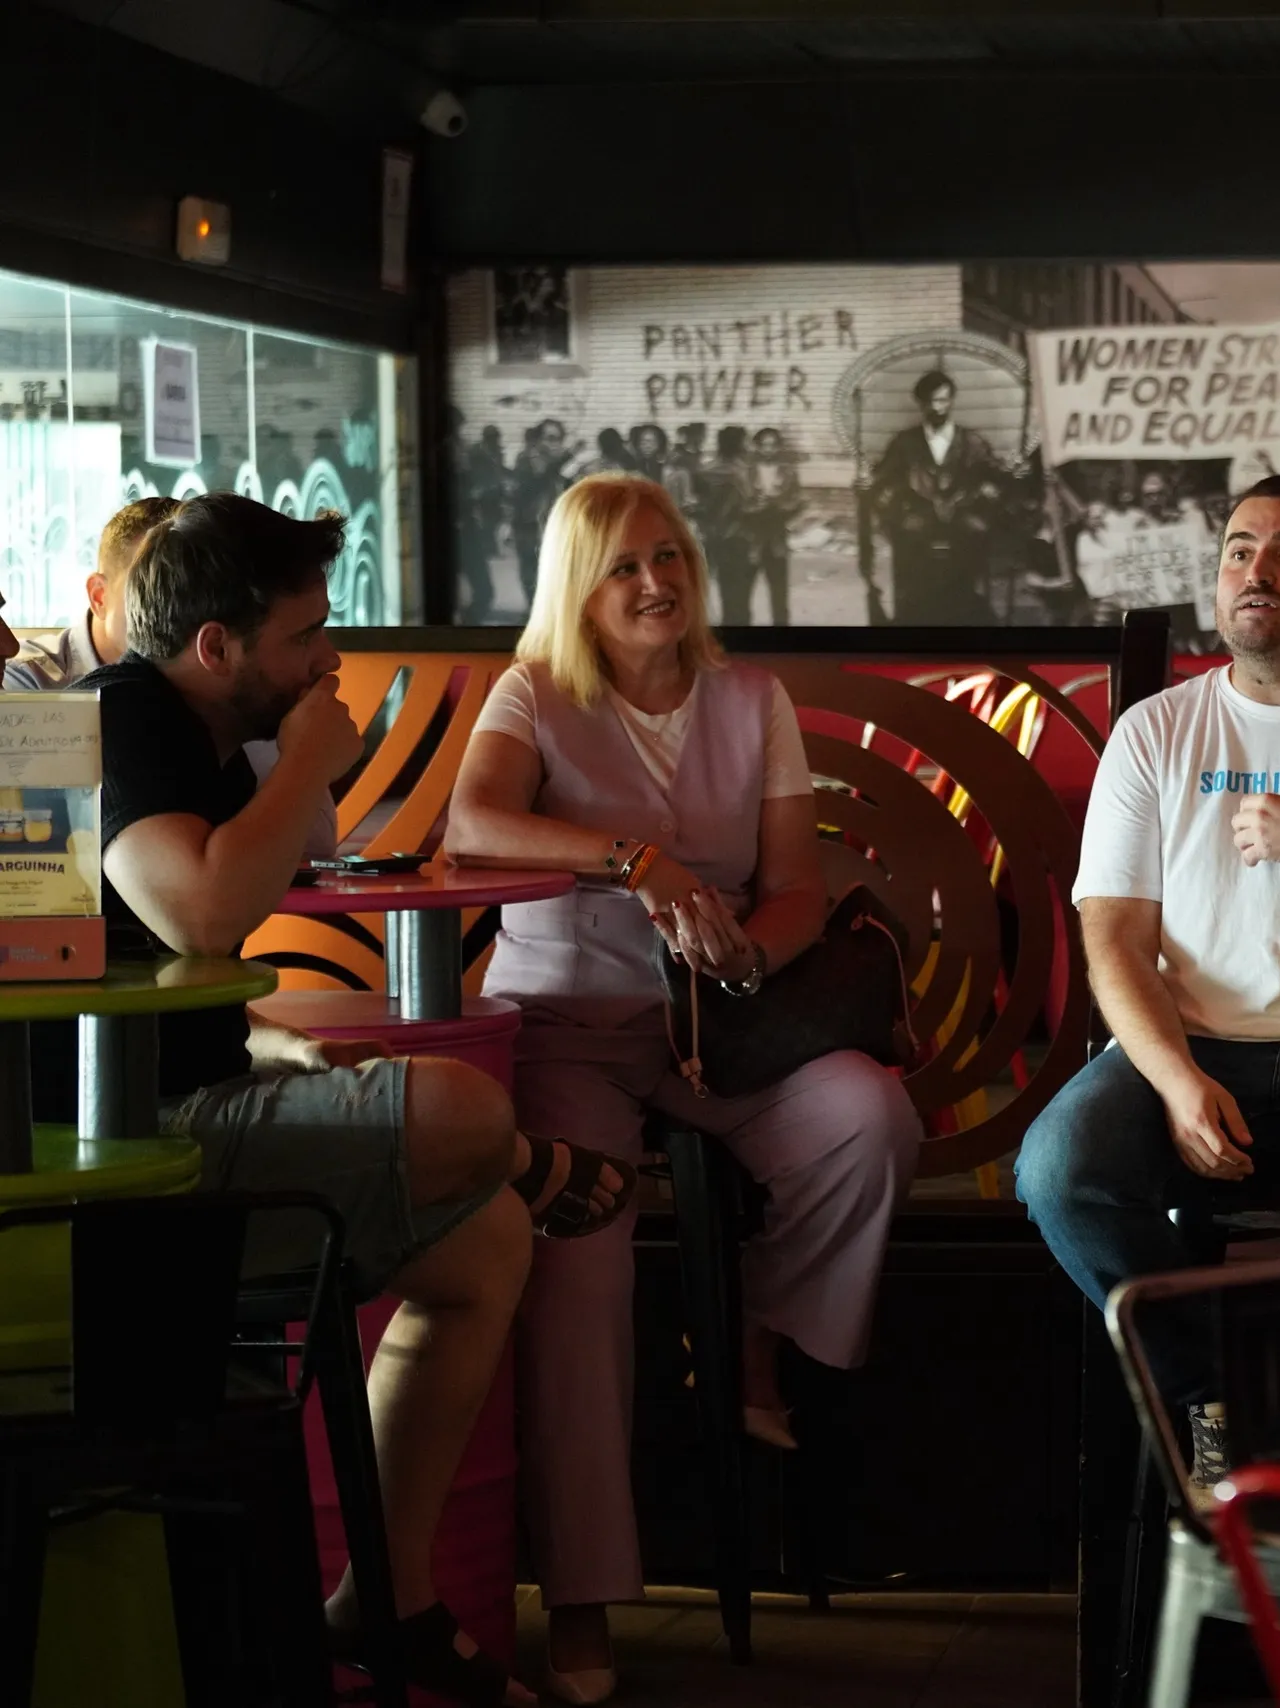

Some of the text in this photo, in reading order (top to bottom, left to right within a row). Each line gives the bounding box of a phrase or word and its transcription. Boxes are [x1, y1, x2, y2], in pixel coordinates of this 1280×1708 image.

[643, 309, 858, 361] PANTHER
[1056, 336, 1208, 387] WOMEN
[645, 365, 812, 419] POWER
[1101, 375, 1191, 408] FOR
[1061, 411, 1134, 448] AND
[1200, 770, 1267, 794] SOUTH
